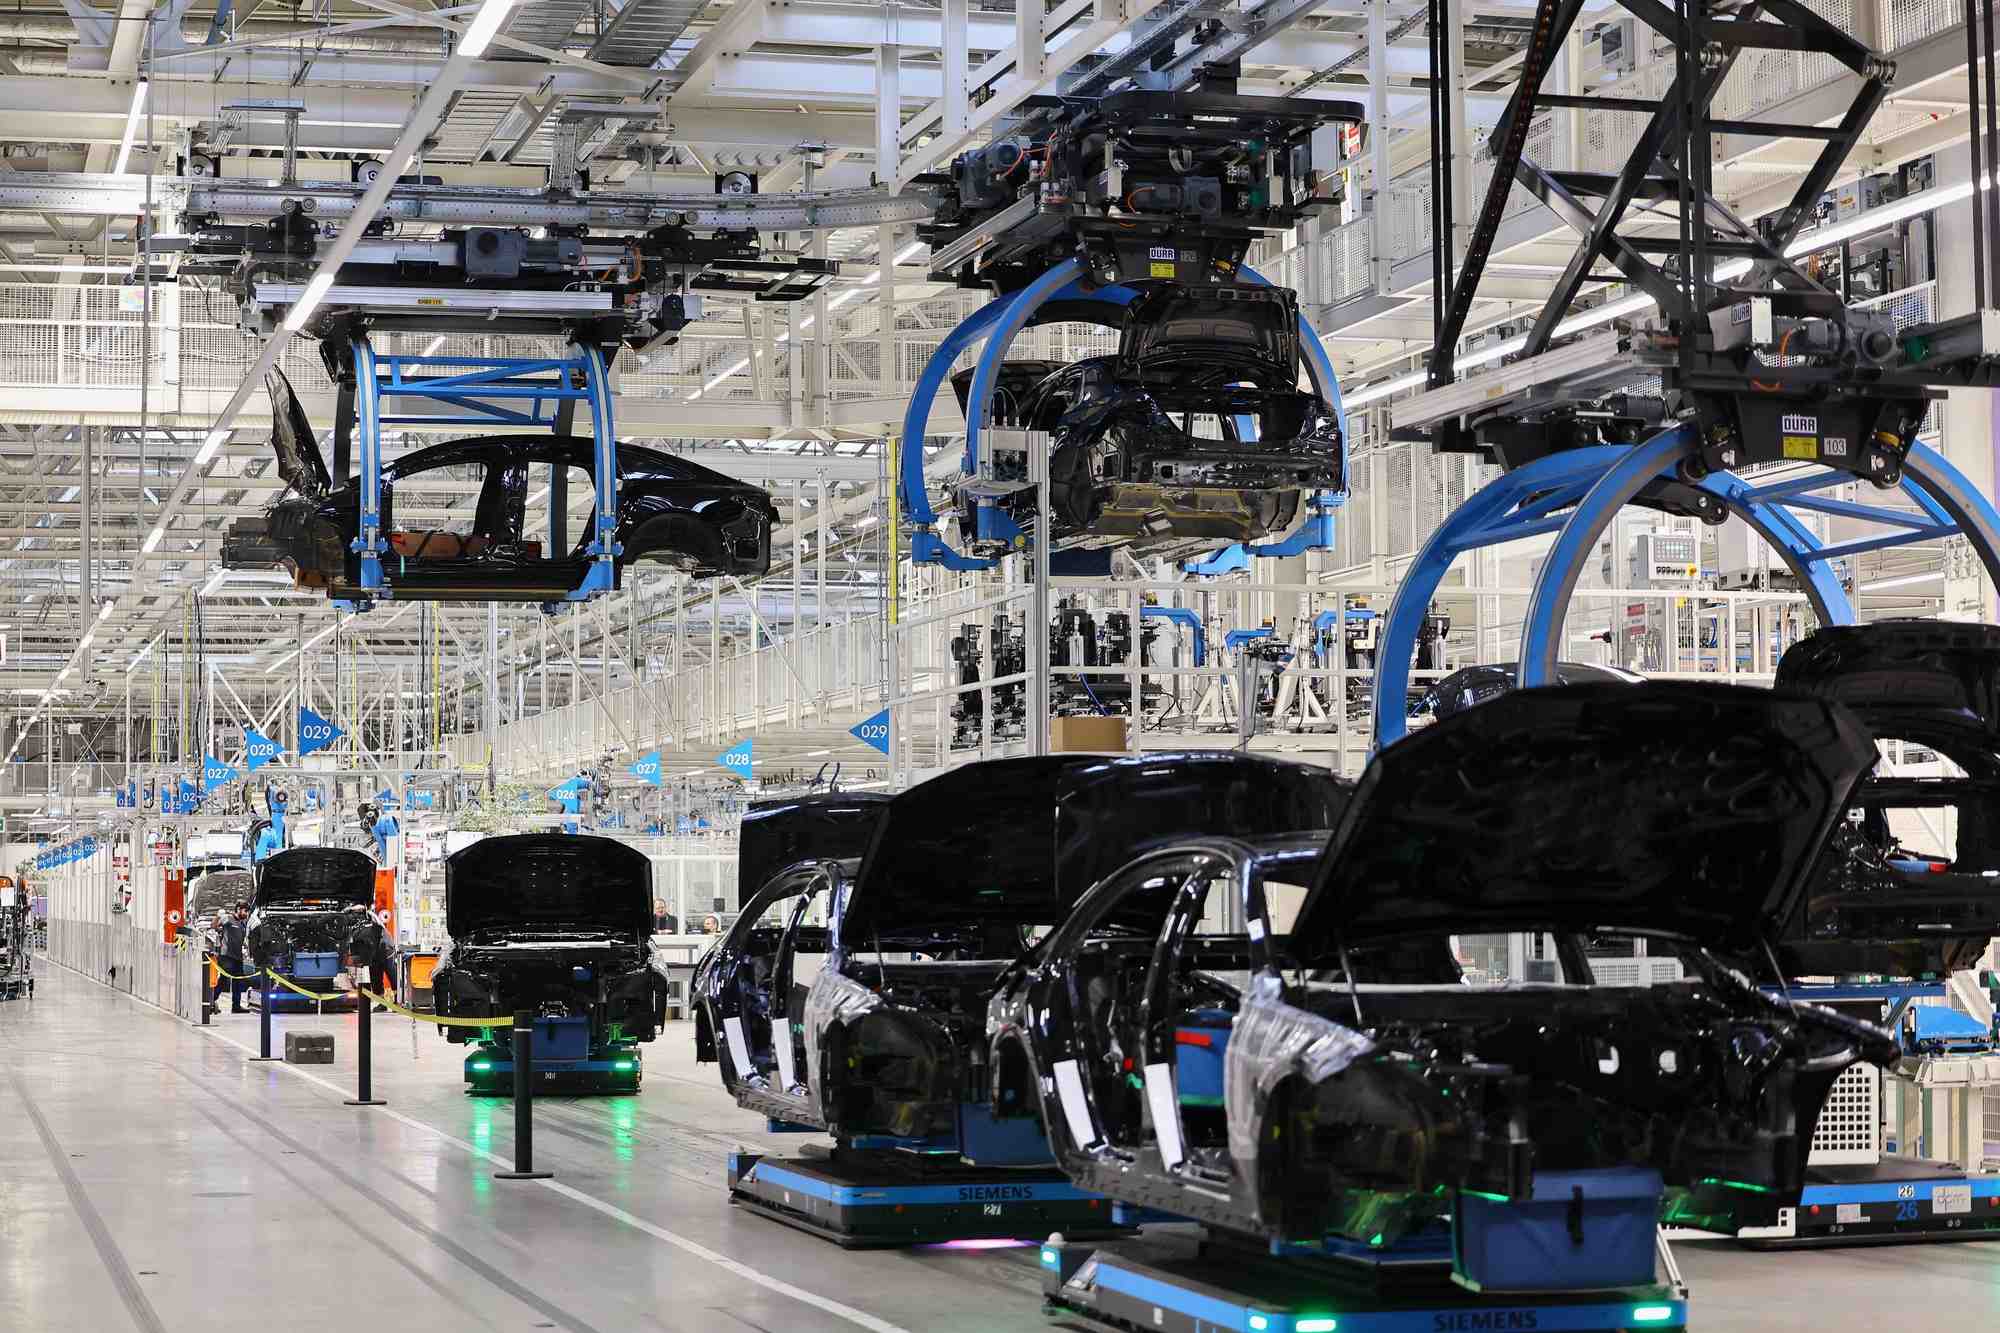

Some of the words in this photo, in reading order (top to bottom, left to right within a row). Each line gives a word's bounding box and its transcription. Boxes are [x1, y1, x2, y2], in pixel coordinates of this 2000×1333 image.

[1826, 439, 1845, 454] 103
[303, 725, 332, 739] 029
[861, 725, 888, 738] 029
[250, 744, 274, 756] 028
[726, 753, 750, 766] 028
[207, 768, 229, 779] 027
[636, 763, 657, 775] 027
[556, 789, 575, 799] 026
[959, 1185, 1033, 1201] SIEMENS
[1899, 1186, 1914, 1198] 26
[1895, 1201, 1919, 1221] 26
[1432, 1311, 1537, 1332] SIEMENS
